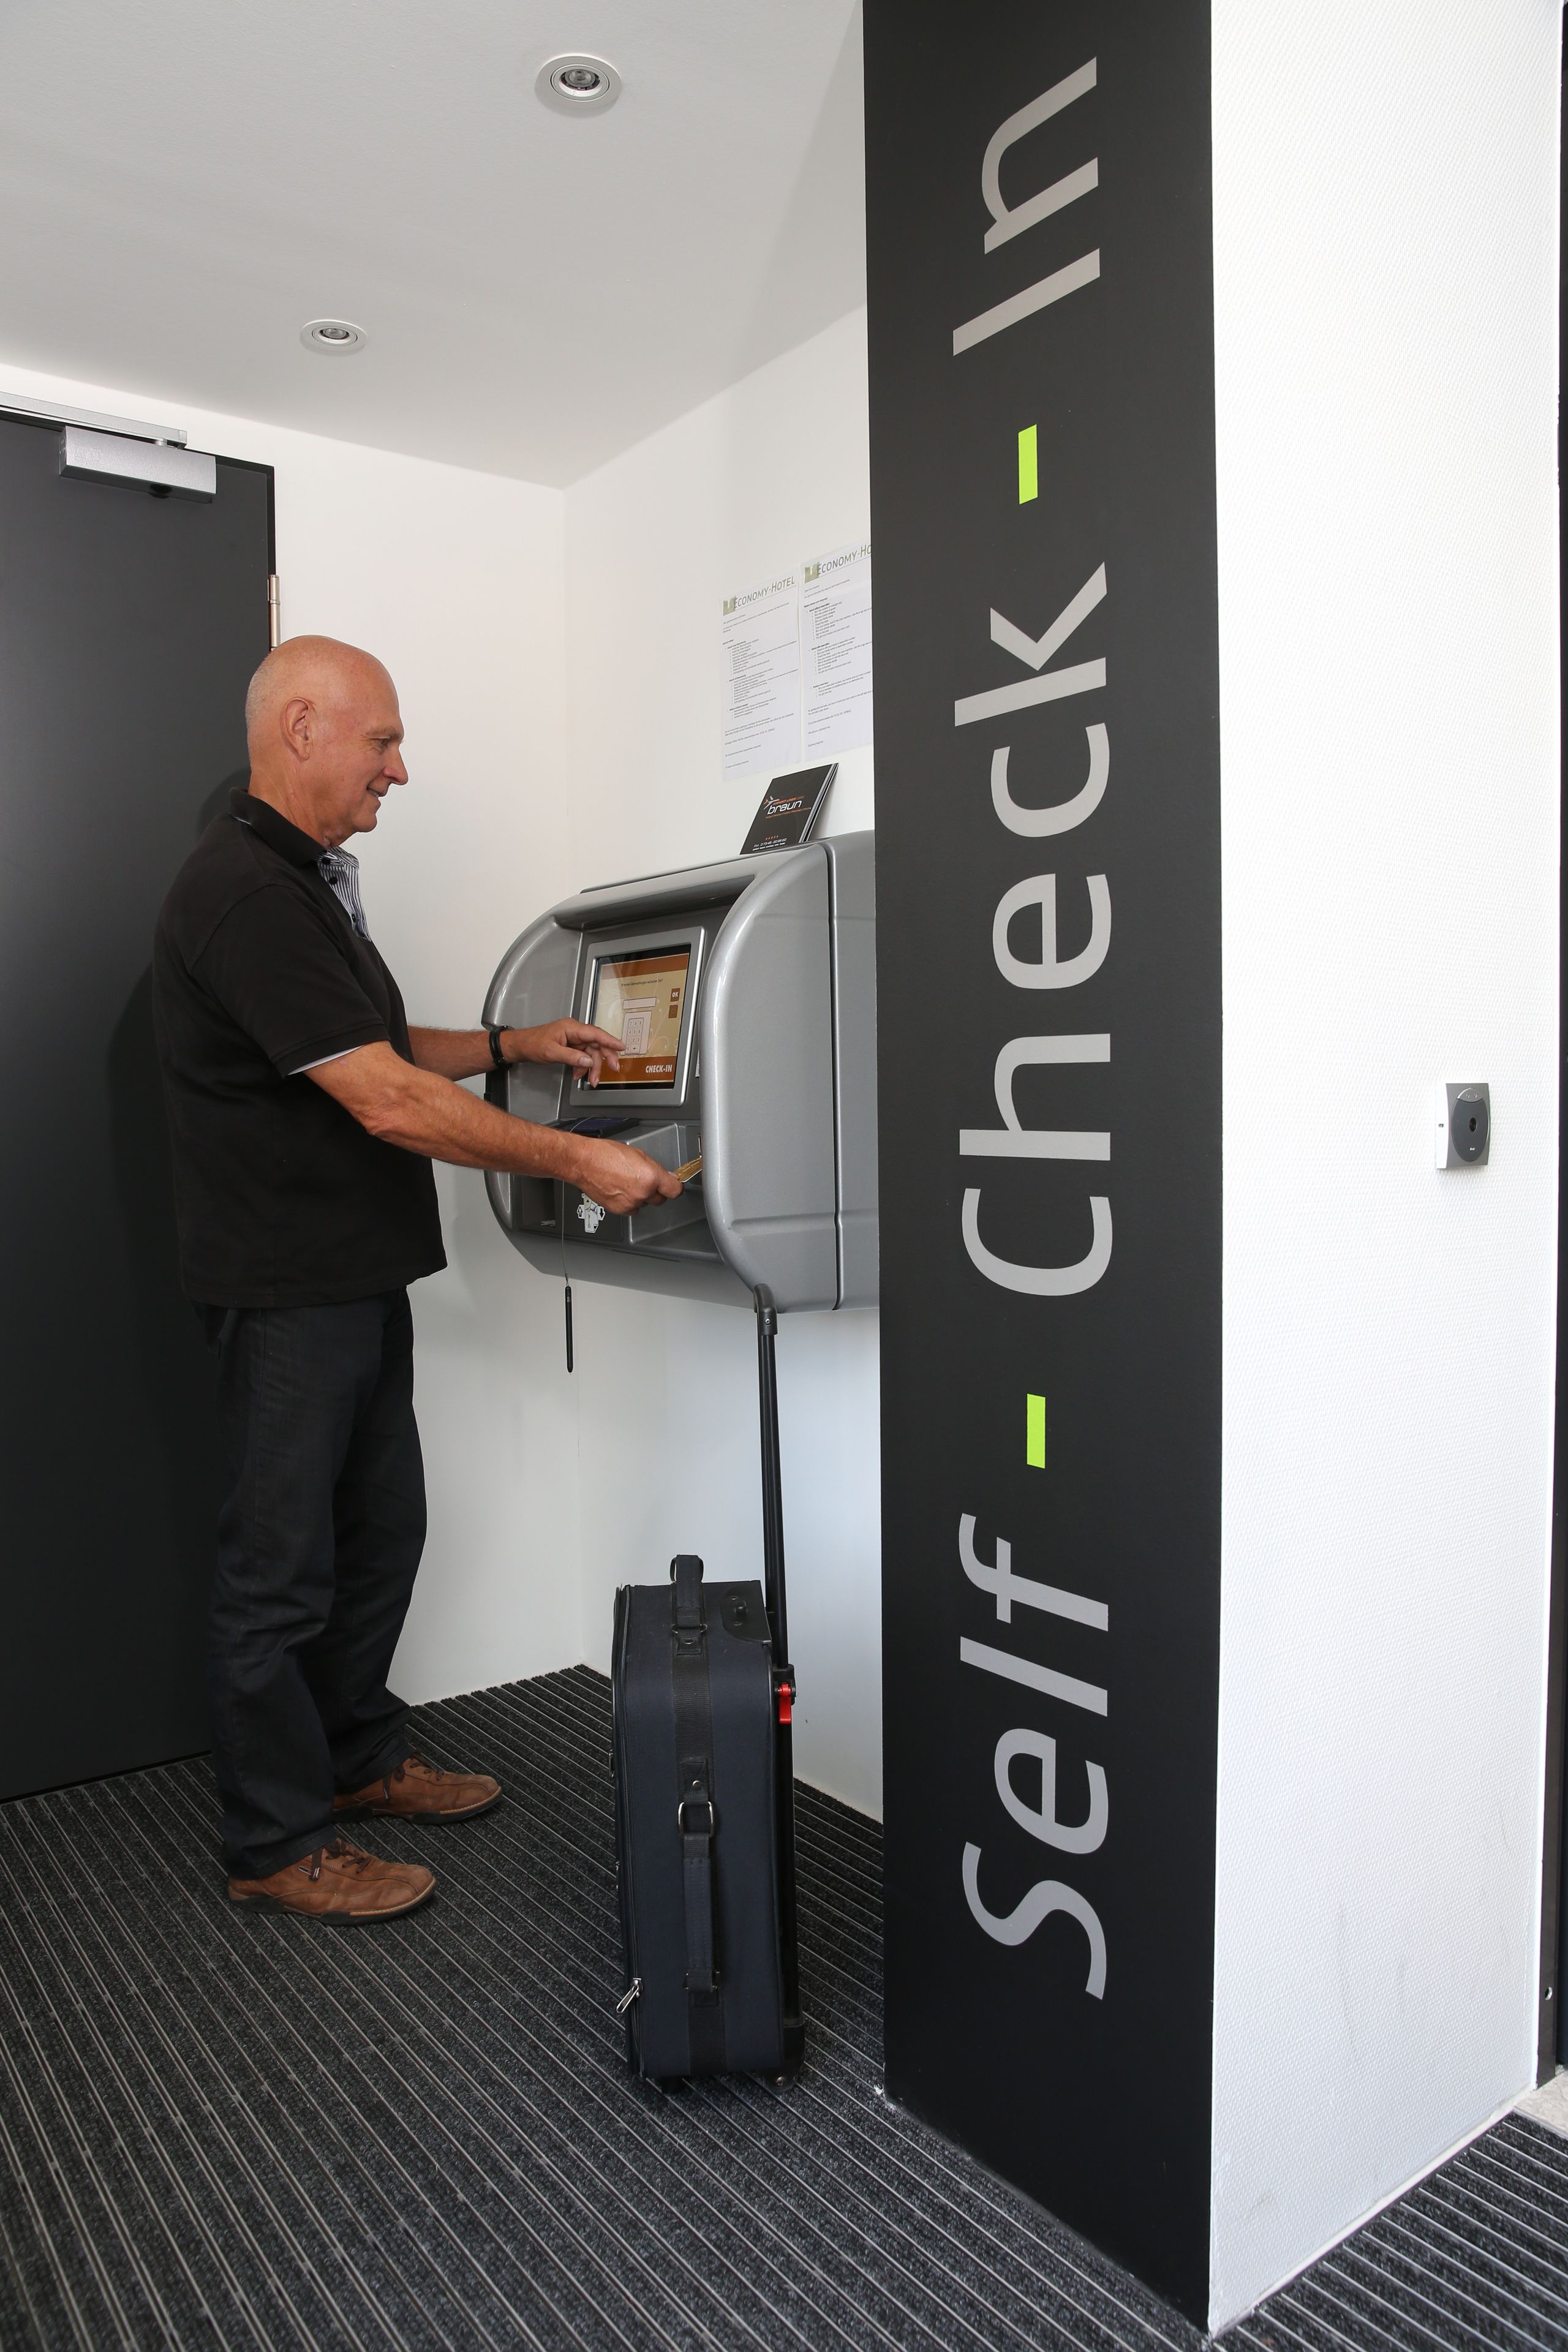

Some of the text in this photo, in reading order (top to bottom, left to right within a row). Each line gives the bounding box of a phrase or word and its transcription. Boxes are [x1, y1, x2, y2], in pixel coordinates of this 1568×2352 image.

[953, 57, 1101, 356] In
[734, 576, 795, 608] ECONOMY-HOTEL
[767, 801, 802, 815] braun
[955, 562, 1112, 1295] Check
[646, 1065, 673, 1073] CHECK-IN
[959, 1513, 1109, 1999] Self
